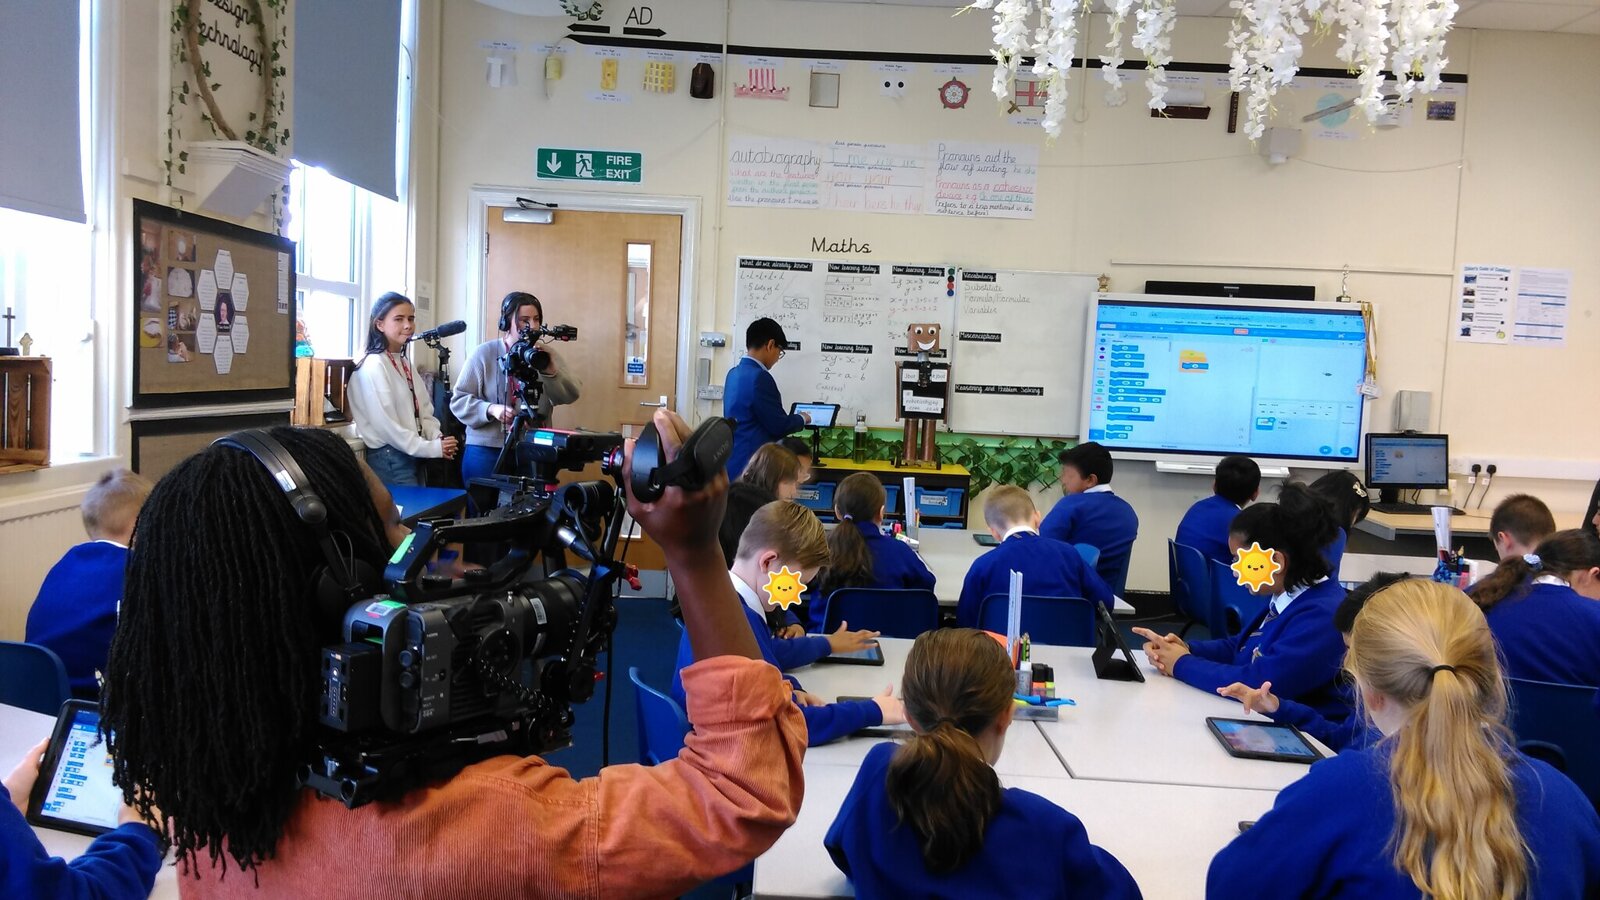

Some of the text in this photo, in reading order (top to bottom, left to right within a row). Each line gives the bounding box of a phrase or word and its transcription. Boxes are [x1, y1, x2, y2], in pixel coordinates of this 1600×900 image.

[625, 6, 653, 25] AD
[199, 19, 262, 76] echnology
[606, 155, 632, 166] FIRE
[729, 146, 821, 175] autobiography
[937, 143, 1017, 164] Pronouns aid the
[605, 168, 632, 179] EXIT
[976, 164, 1008, 178] writing
[811, 237, 872, 253] Maths
